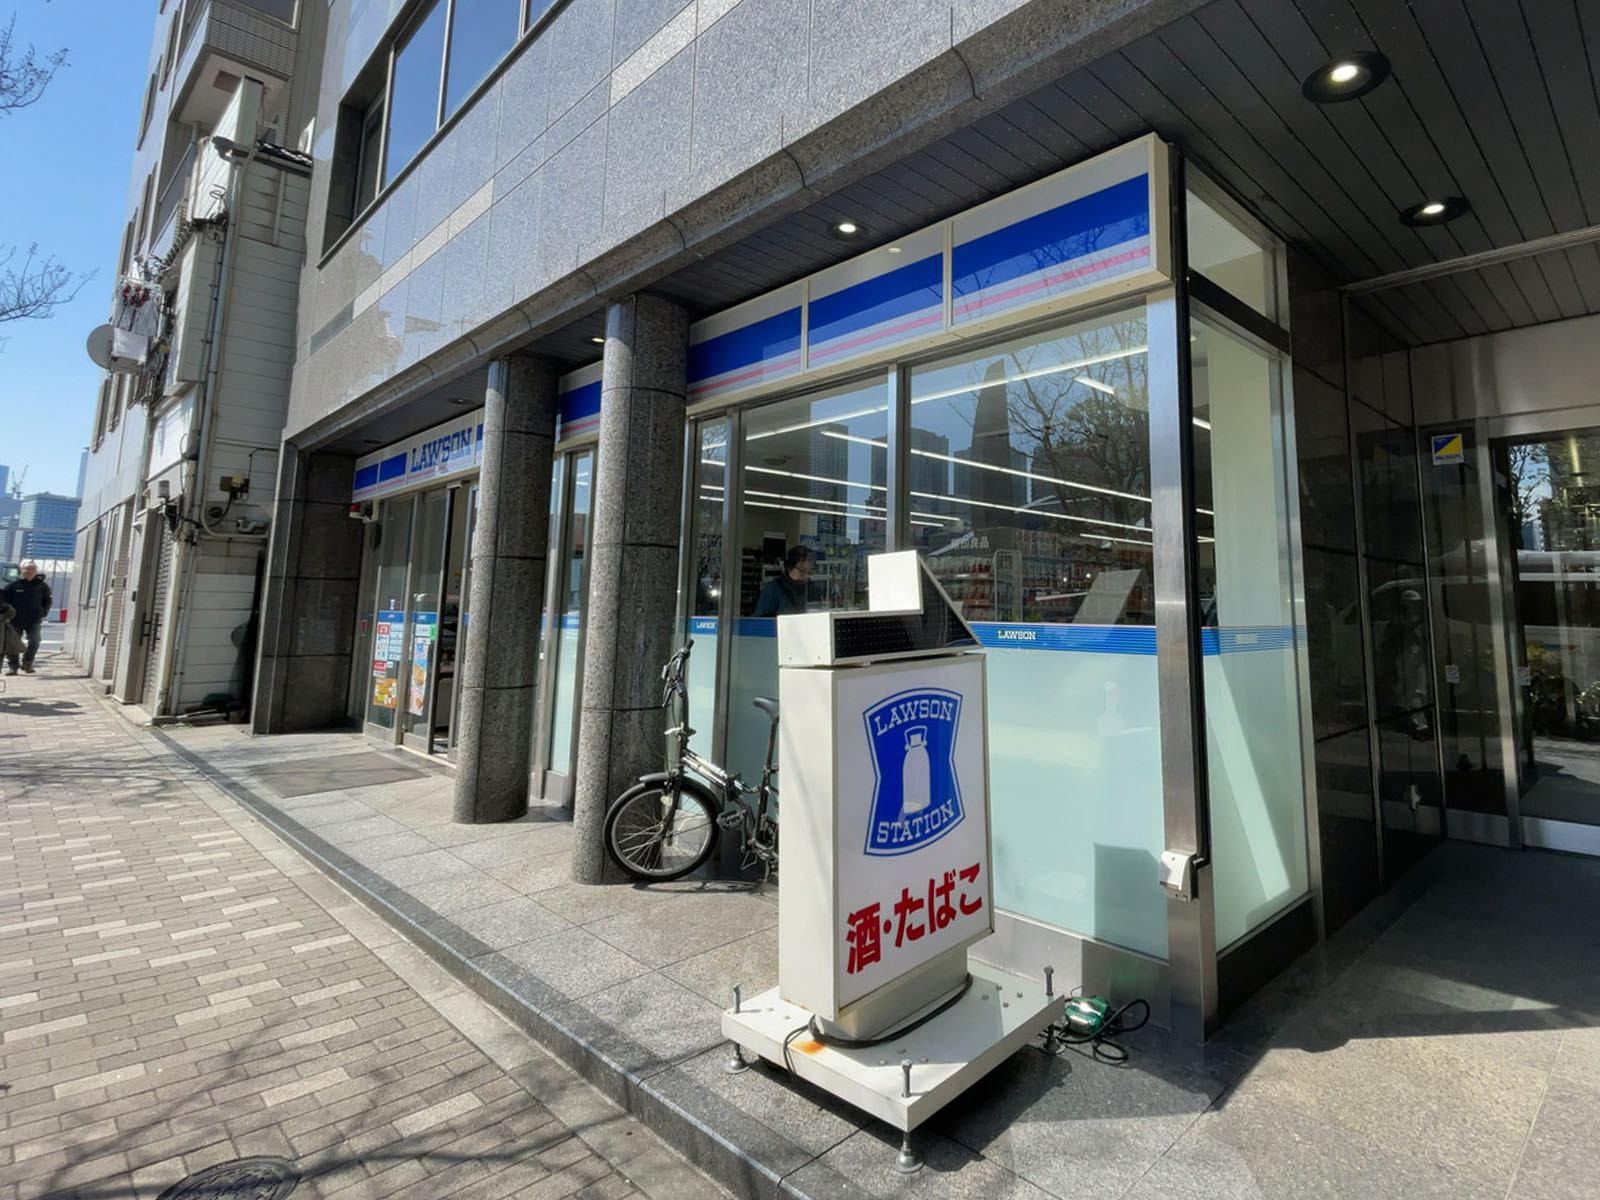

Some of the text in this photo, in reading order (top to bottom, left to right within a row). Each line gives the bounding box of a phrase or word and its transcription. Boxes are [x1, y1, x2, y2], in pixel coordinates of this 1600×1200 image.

[411, 427, 472, 473] LAWSON
[997, 630, 1036, 640] LAWSON
[875, 699, 953, 736] LAWSON
[876, 800, 954, 844] STATION
